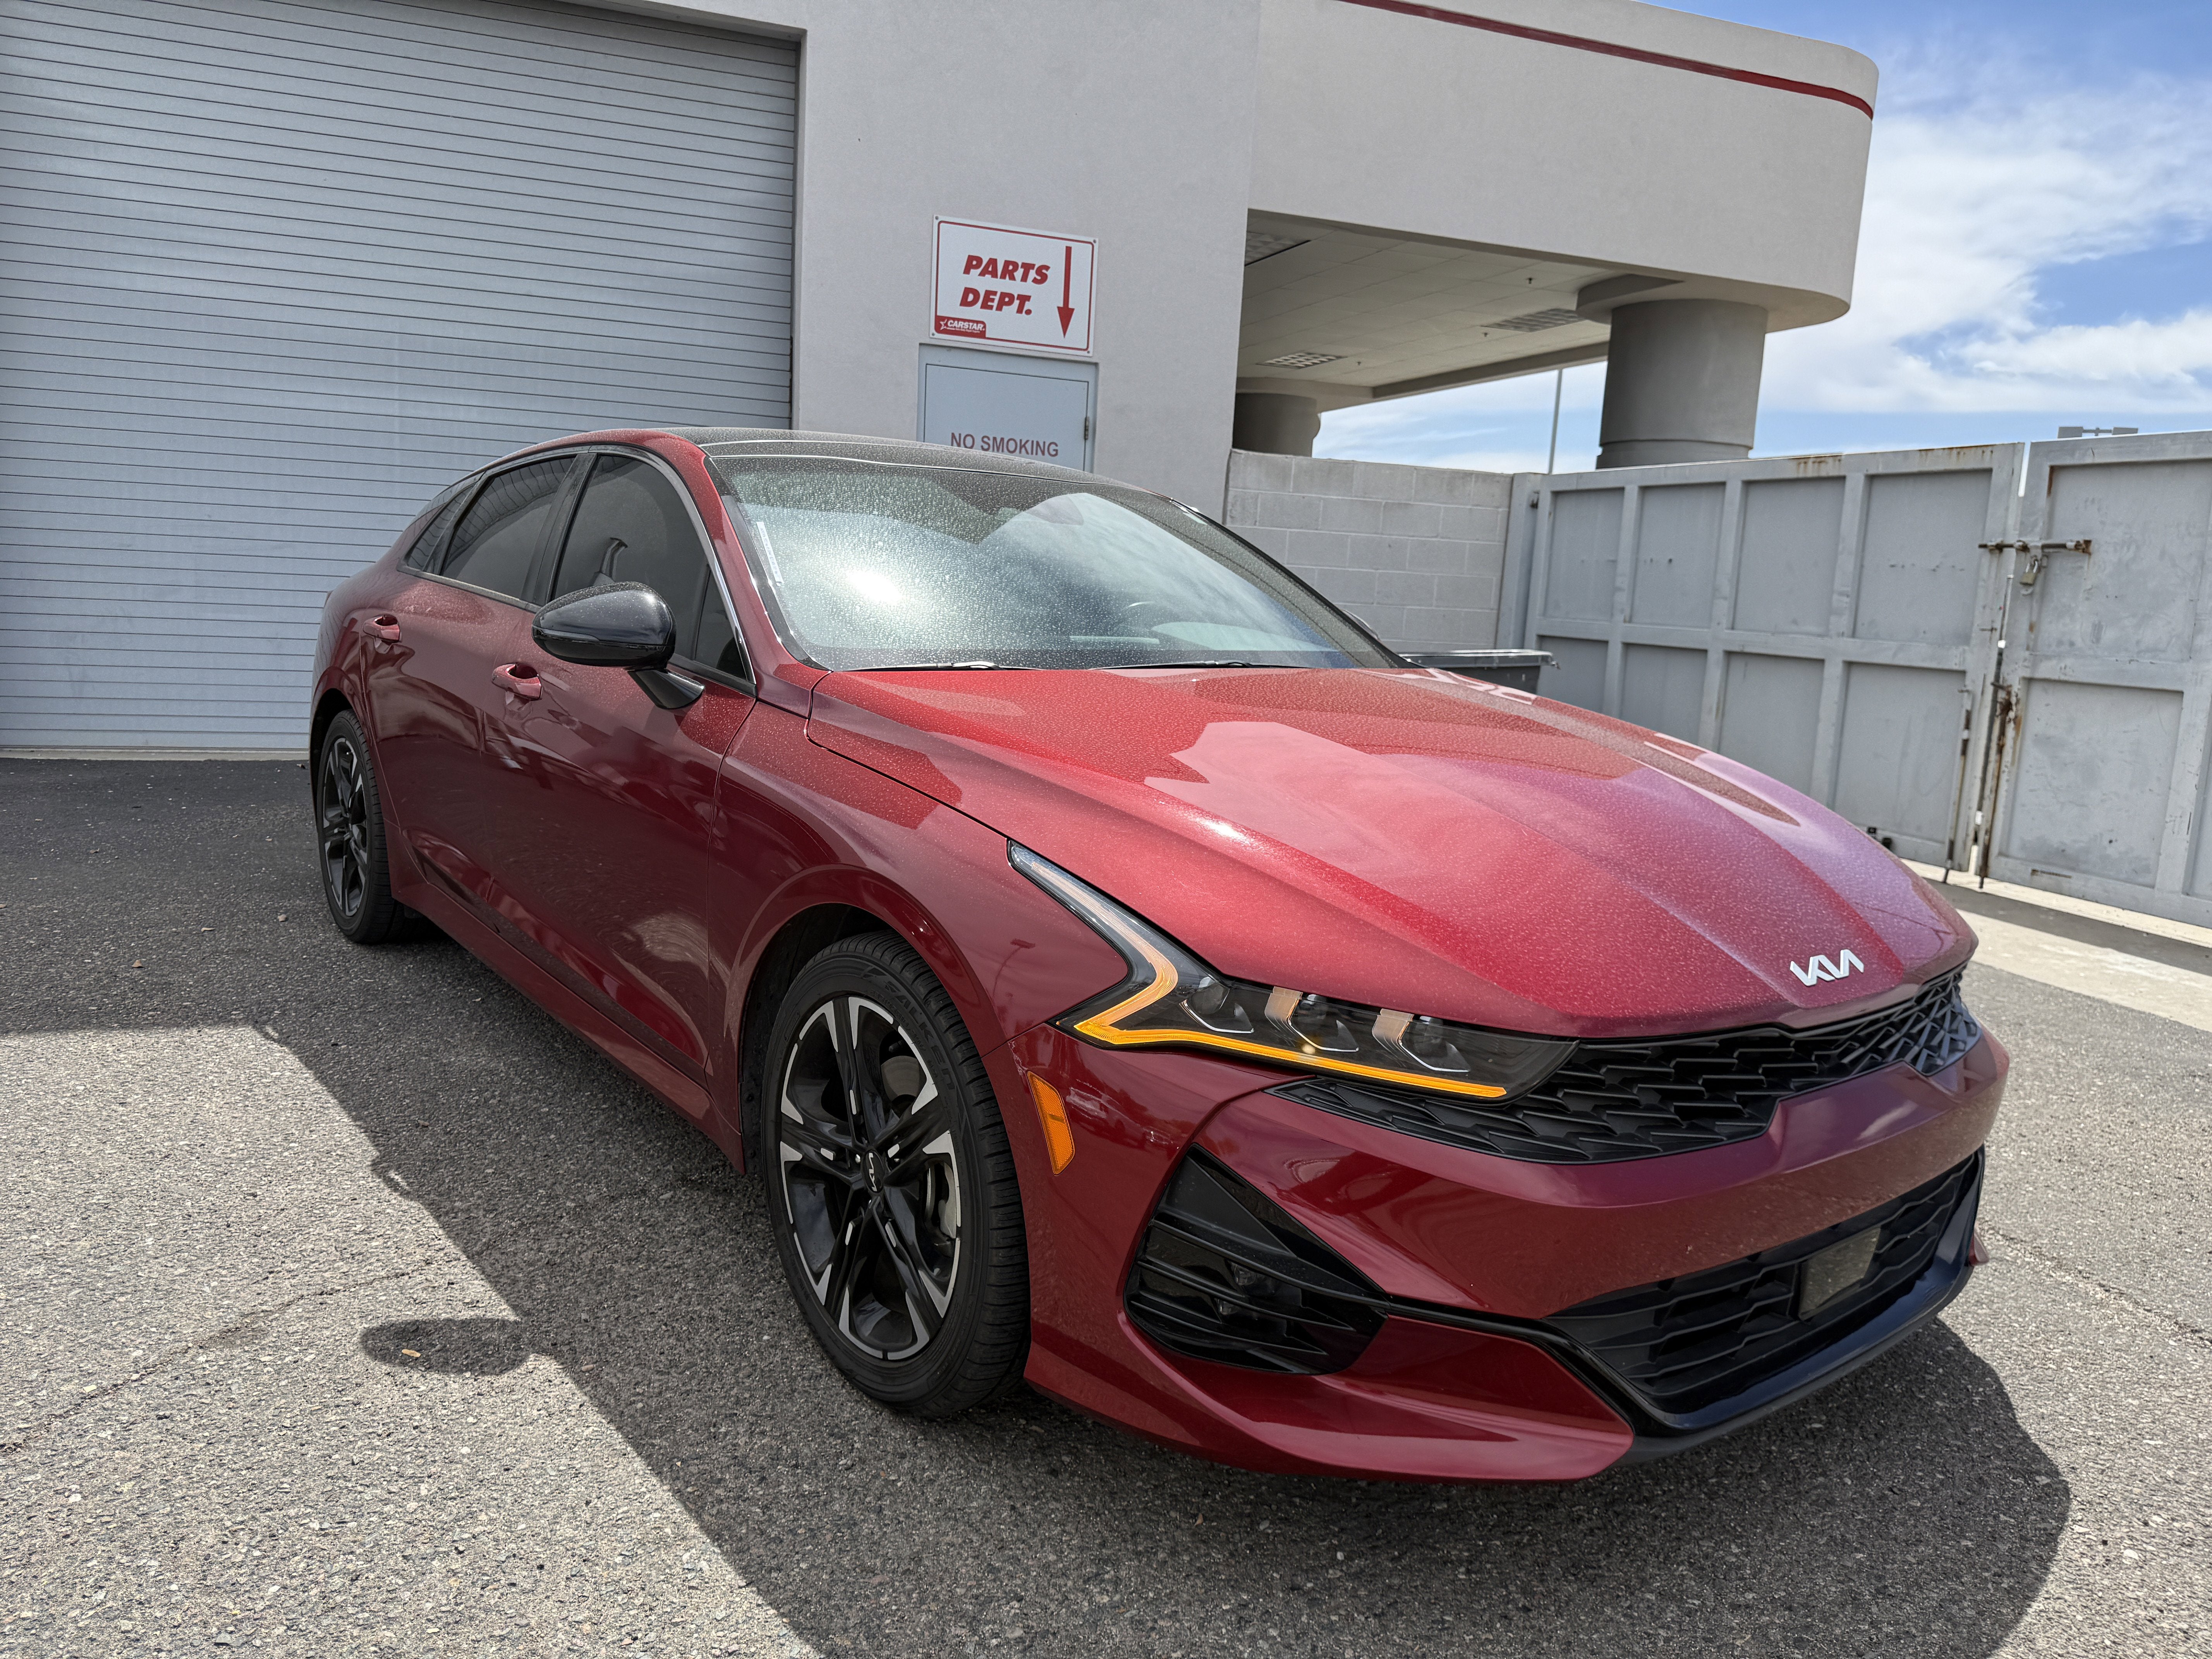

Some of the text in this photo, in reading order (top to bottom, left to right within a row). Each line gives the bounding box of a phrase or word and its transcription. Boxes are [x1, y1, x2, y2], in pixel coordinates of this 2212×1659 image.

[963, 255, 1051, 285] PARTS
[959, 287, 1032, 316] DEPT.
[951, 432, 1058, 457] NO SMOKING
